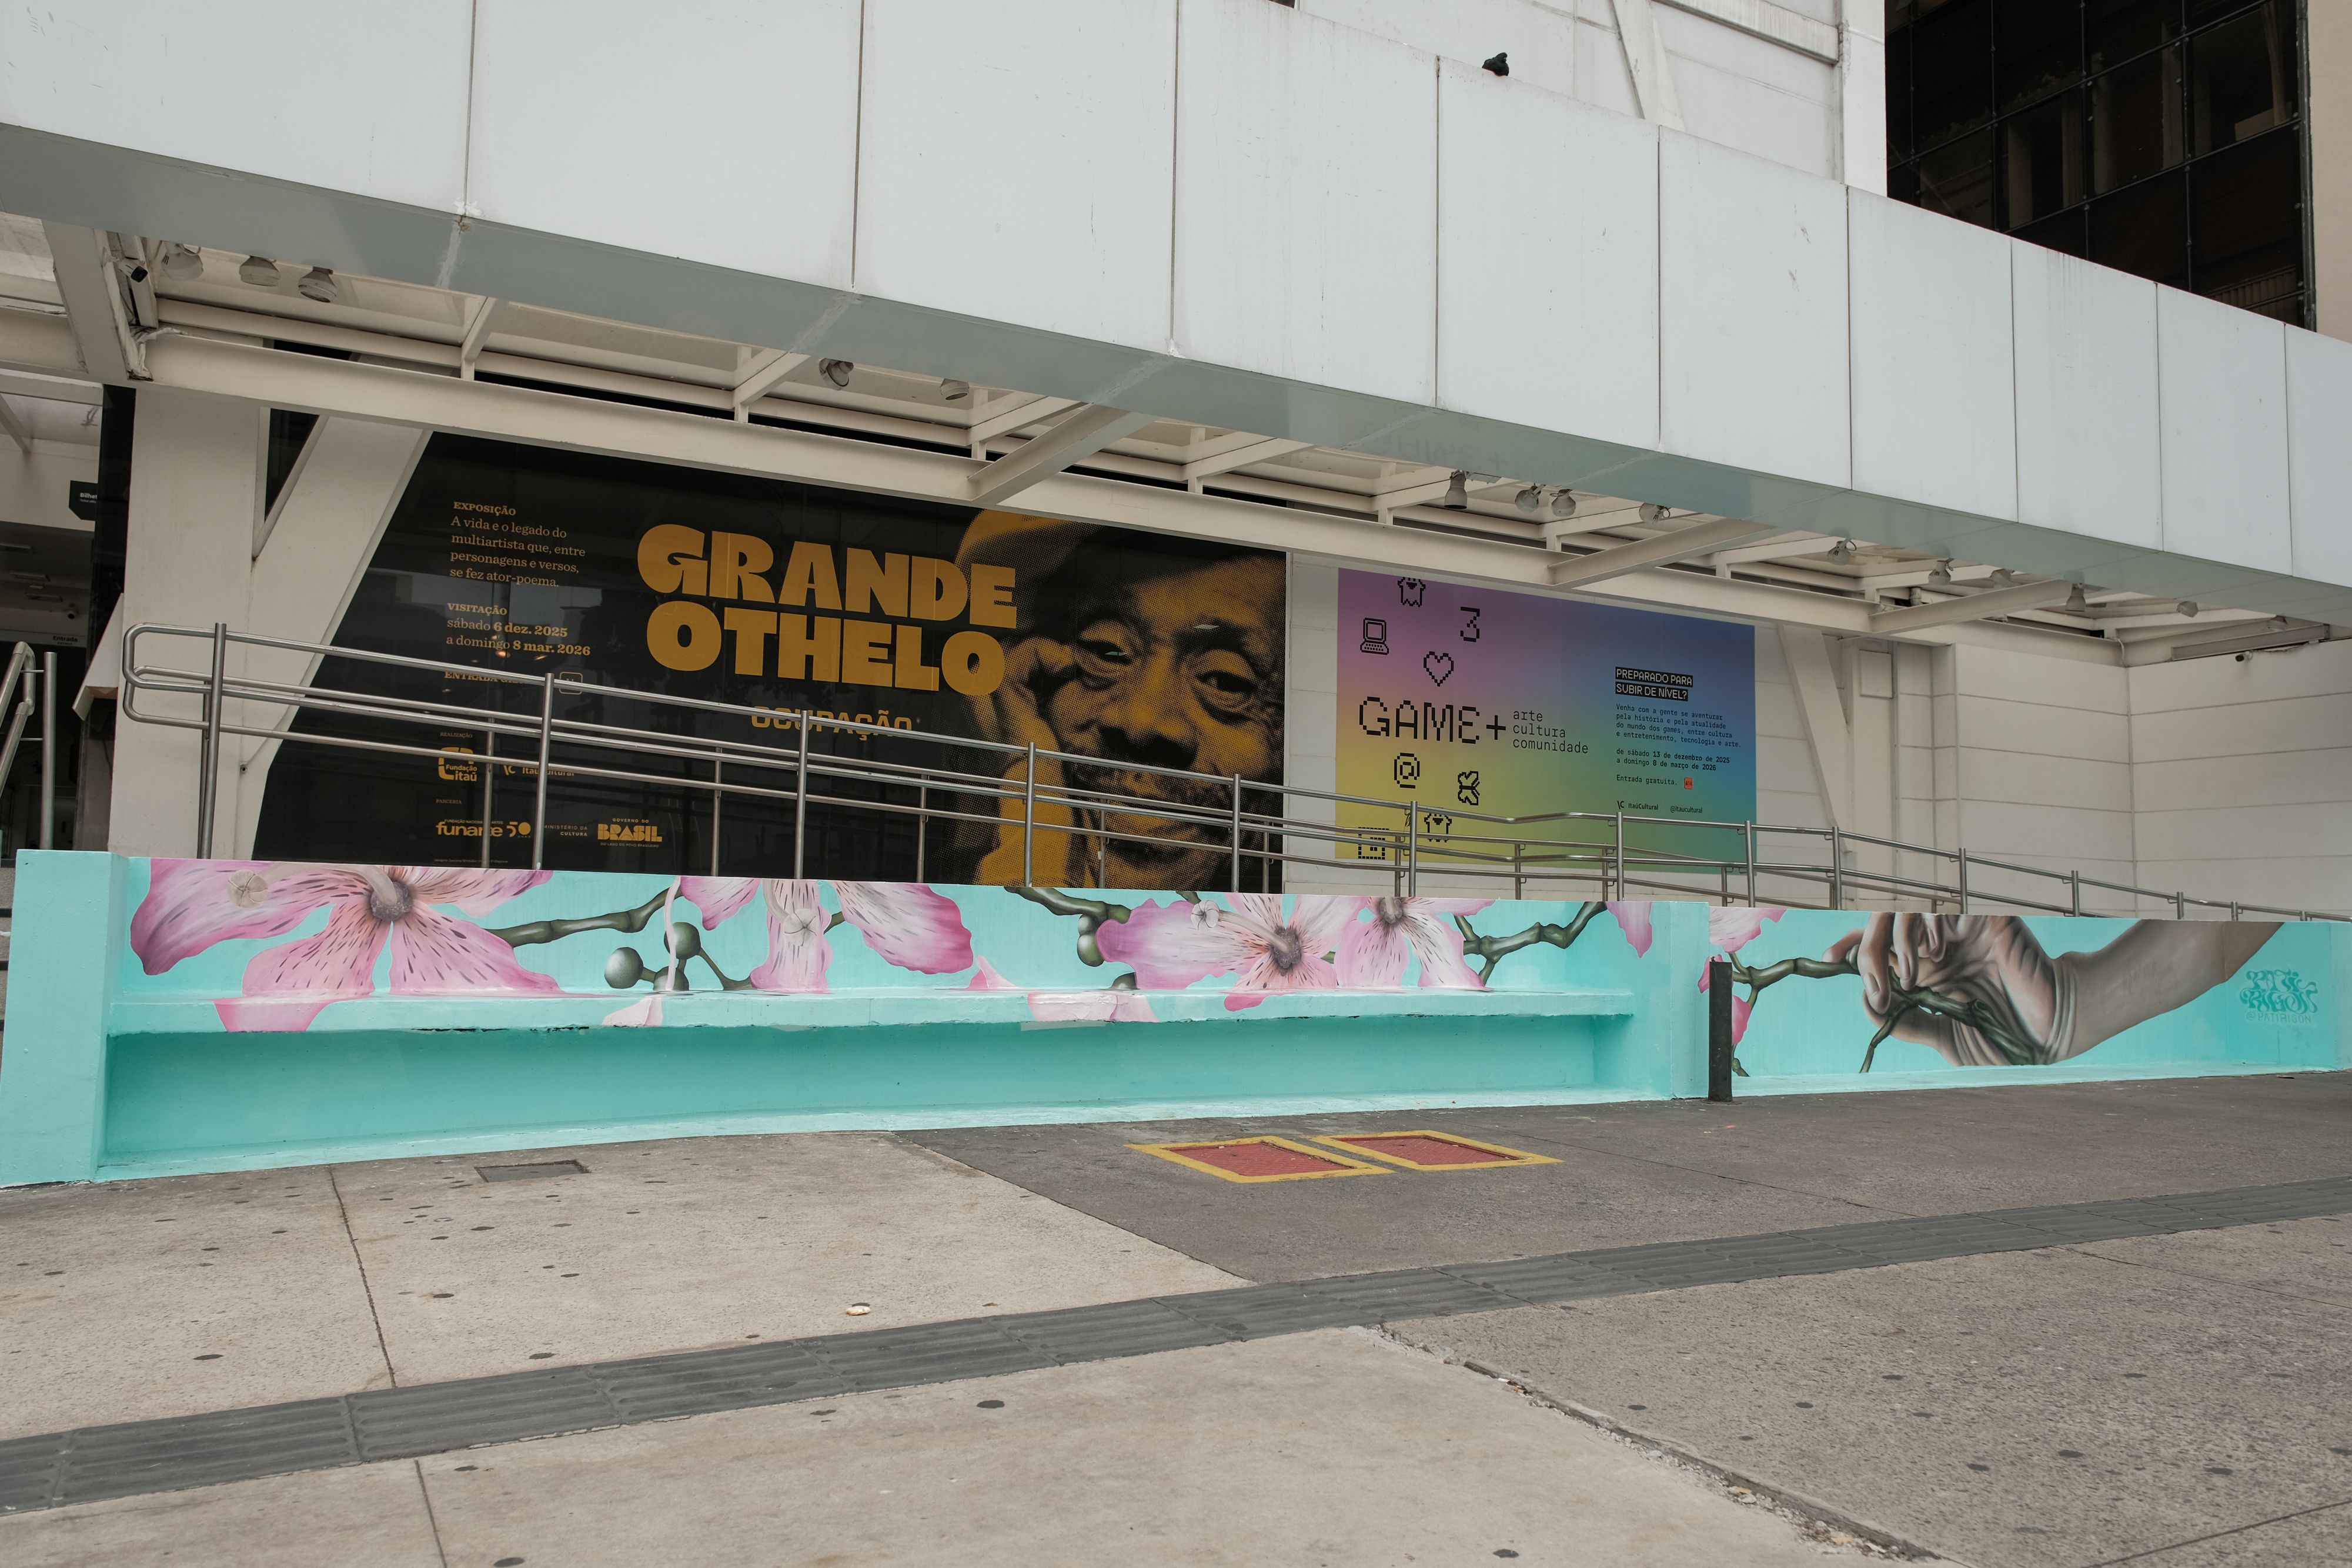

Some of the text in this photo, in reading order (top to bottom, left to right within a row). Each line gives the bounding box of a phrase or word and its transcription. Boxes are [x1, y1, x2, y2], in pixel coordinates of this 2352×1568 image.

[453, 502, 516, 516] EXPOSIÇÃO
[450, 516, 462, 527] A
[463, 517, 490, 530] vida
[502, 523, 509, 531] o
[511, 523, 550, 538] legado
[552, 527, 567, 539] do
[451, 534, 586, 557] multiartista que, entre
[450, 551, 527, 568] personagens
[539, 561, 579, 574] versos,
[450, 569, 559, 587] se fez ator-poema.
[637, 524, 1017, 629] GRANDE
[447, 602, 507, 616] VISITAÇÃO
[447, 618, 568, 637] sábado 6 dez. 2025
[446, 635, 590, 656] a domingo 8 mar. 2026
[647, 601, 1004, 696] OTHELO
[1616, 668, 1692, 686] PREPARADO PARA
[1616, 684, 1687, 700] SUBIR DE NÍVEL?
[1513, 710, 1543, 722] arte
[1635, 715, 1663, 723] história
[1692, 720, 1726, 729] atualidade
[1692, 712, 1722, 720] aventurar
[1513, 723, 1566, 738] cultura
[1513, 738, 1588, 754] comunidade
[1623, 731, 1676, 743] entretenimento,
[1681, 737, 1715, 746] tecnologia
[1624, 758, 1649, 766] domingo
[1628, 748, 1649, 757] sábado
[1674, 753, 1702, 761] dezembro
[446, 764, 477, 774] Fundação
[1616, 774, 1642, 783] Entrada
[1646, 777, 1678, 785] gratuita.
[597, 824, 662, 842] BRASIL
[2247, 1011, 2311, 1024] @PATIRIGON
